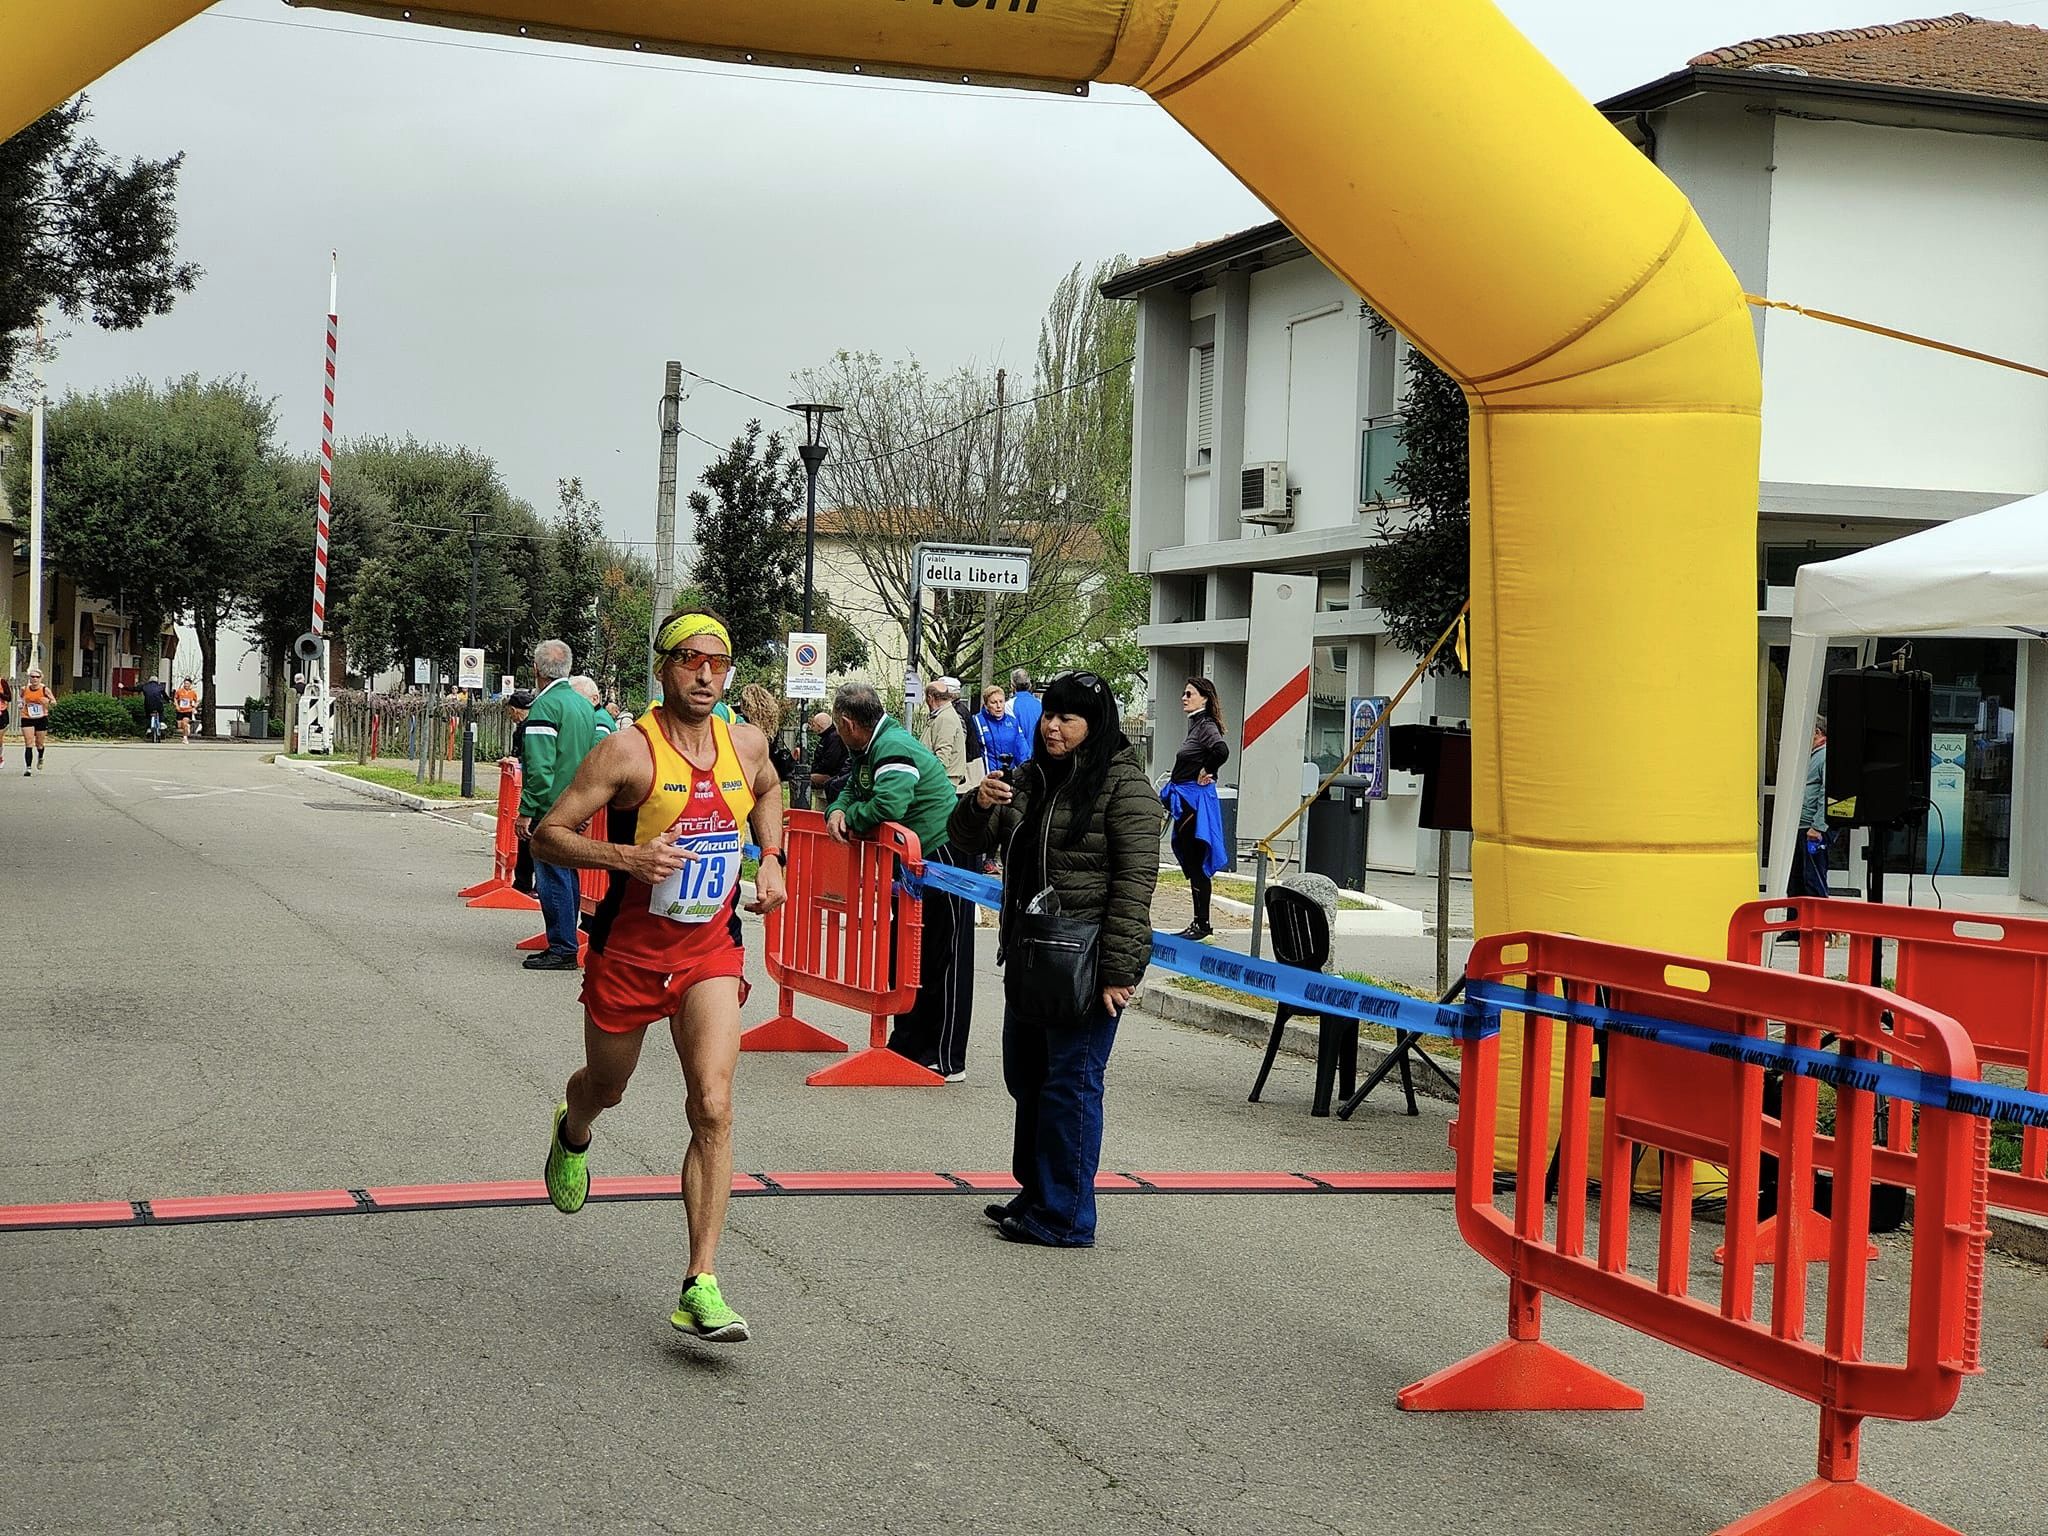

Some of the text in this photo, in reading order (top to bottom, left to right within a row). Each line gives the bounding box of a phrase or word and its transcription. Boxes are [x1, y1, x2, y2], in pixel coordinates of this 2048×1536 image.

[926, 565, 1018, 585] della Liberta
[671, 818, 736, 832] TLETICA
[679, 856, 726, 900] 173
[1804, 1060, 1880, 1092] ATTENZIONE
